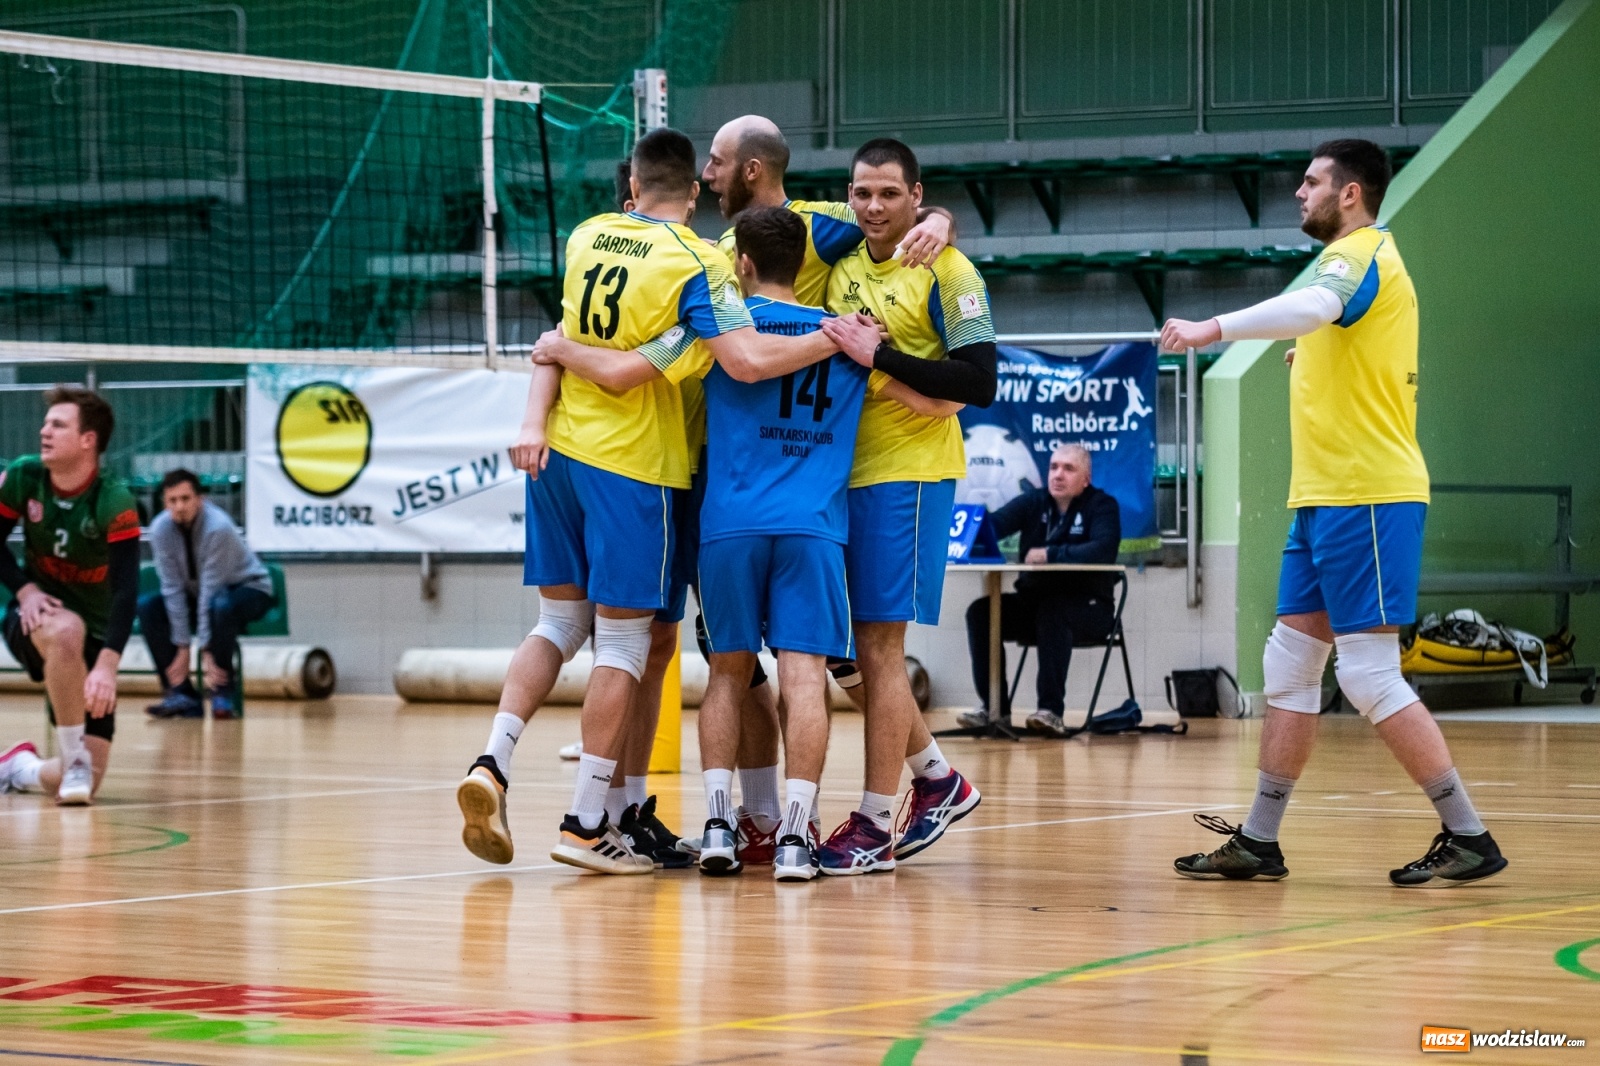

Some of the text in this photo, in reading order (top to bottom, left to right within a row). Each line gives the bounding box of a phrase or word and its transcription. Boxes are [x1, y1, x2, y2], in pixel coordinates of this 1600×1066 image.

[592, 233, 653, 259] GARDYAN
[579, 263, 628, 341] 13
[779, 357, 832, 422] 14
[1036, 378, 1119, 402] SPORT
[760, 426, 812, 442] SIATKARSKI
[1032, 410, 1118, 432] Racibórz
[1103, 438, 1118, 451] 17
[393, 466, 462, 516] JEST
[471, 453, 499, 486] W
[274, 504, 374, 525] RACIBÓRZ
[949, 509, 968, 538] 3
[53, 528, 70, 558] 2
